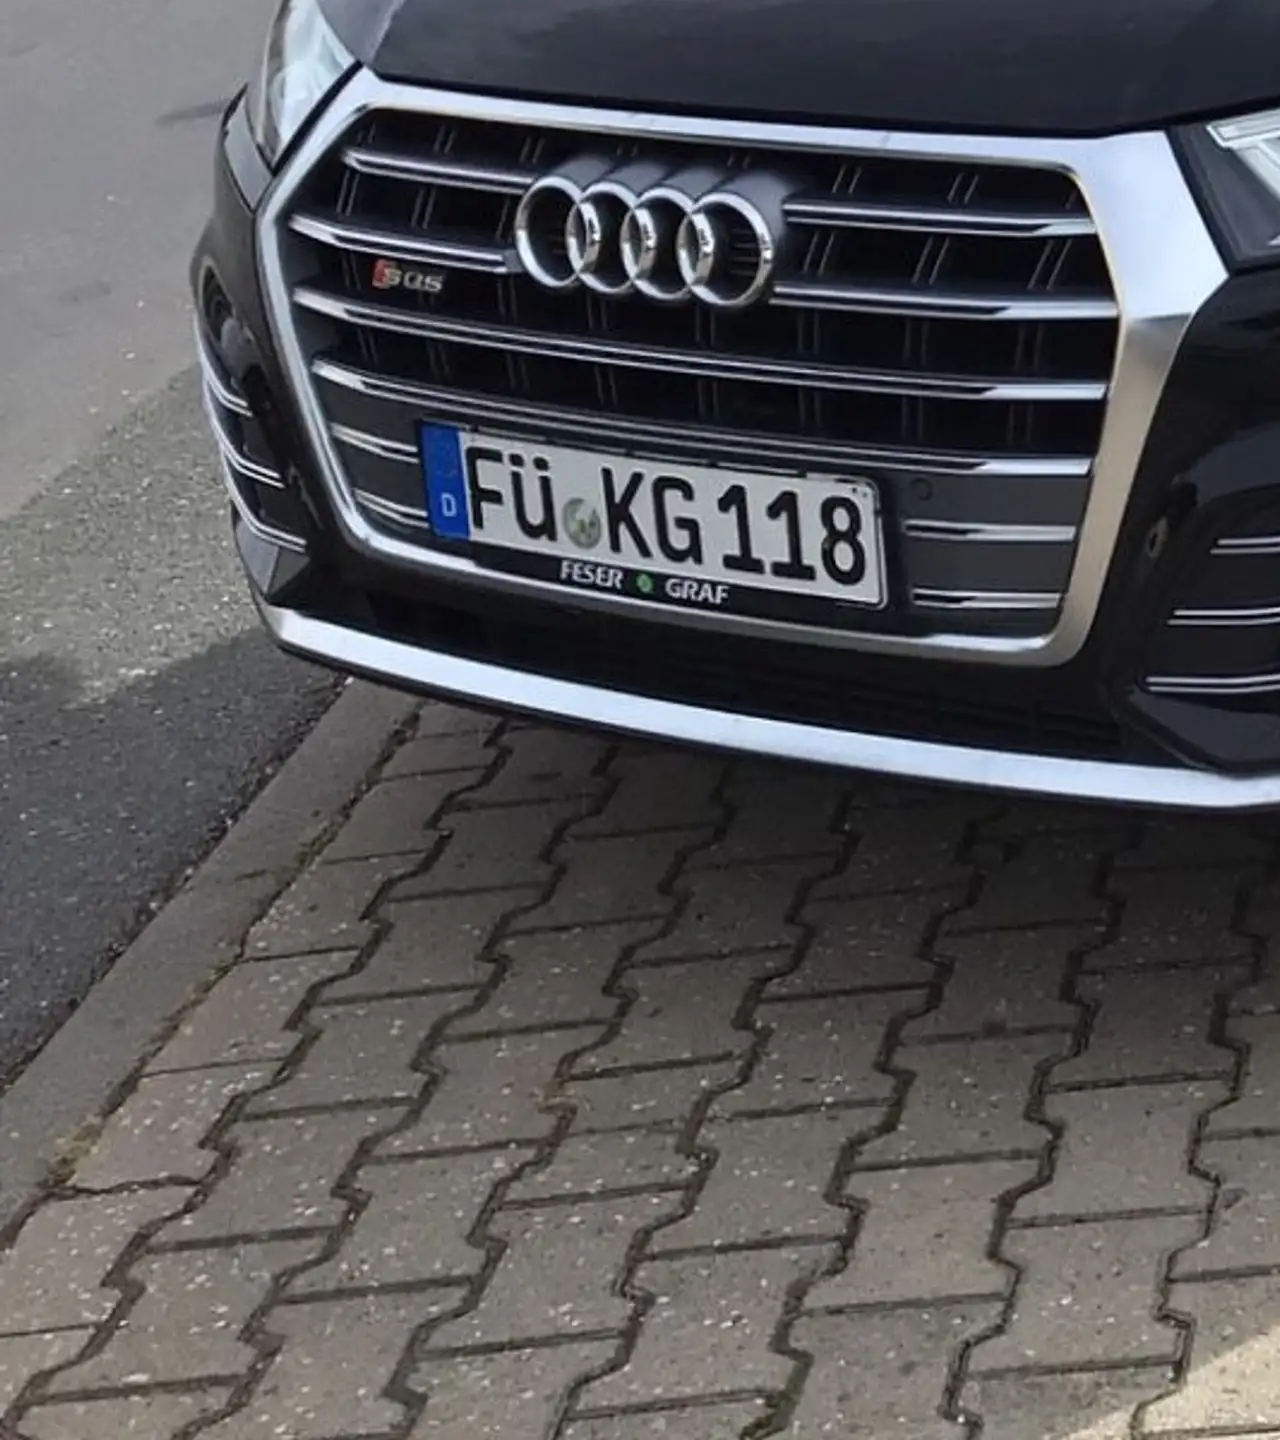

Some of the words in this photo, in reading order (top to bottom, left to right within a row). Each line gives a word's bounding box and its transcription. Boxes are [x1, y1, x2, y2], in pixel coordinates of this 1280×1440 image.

[440, 491, 458, 518] D
[560, 561, 624, 589] FESER
[664, 577, 731, 605] GRAF
